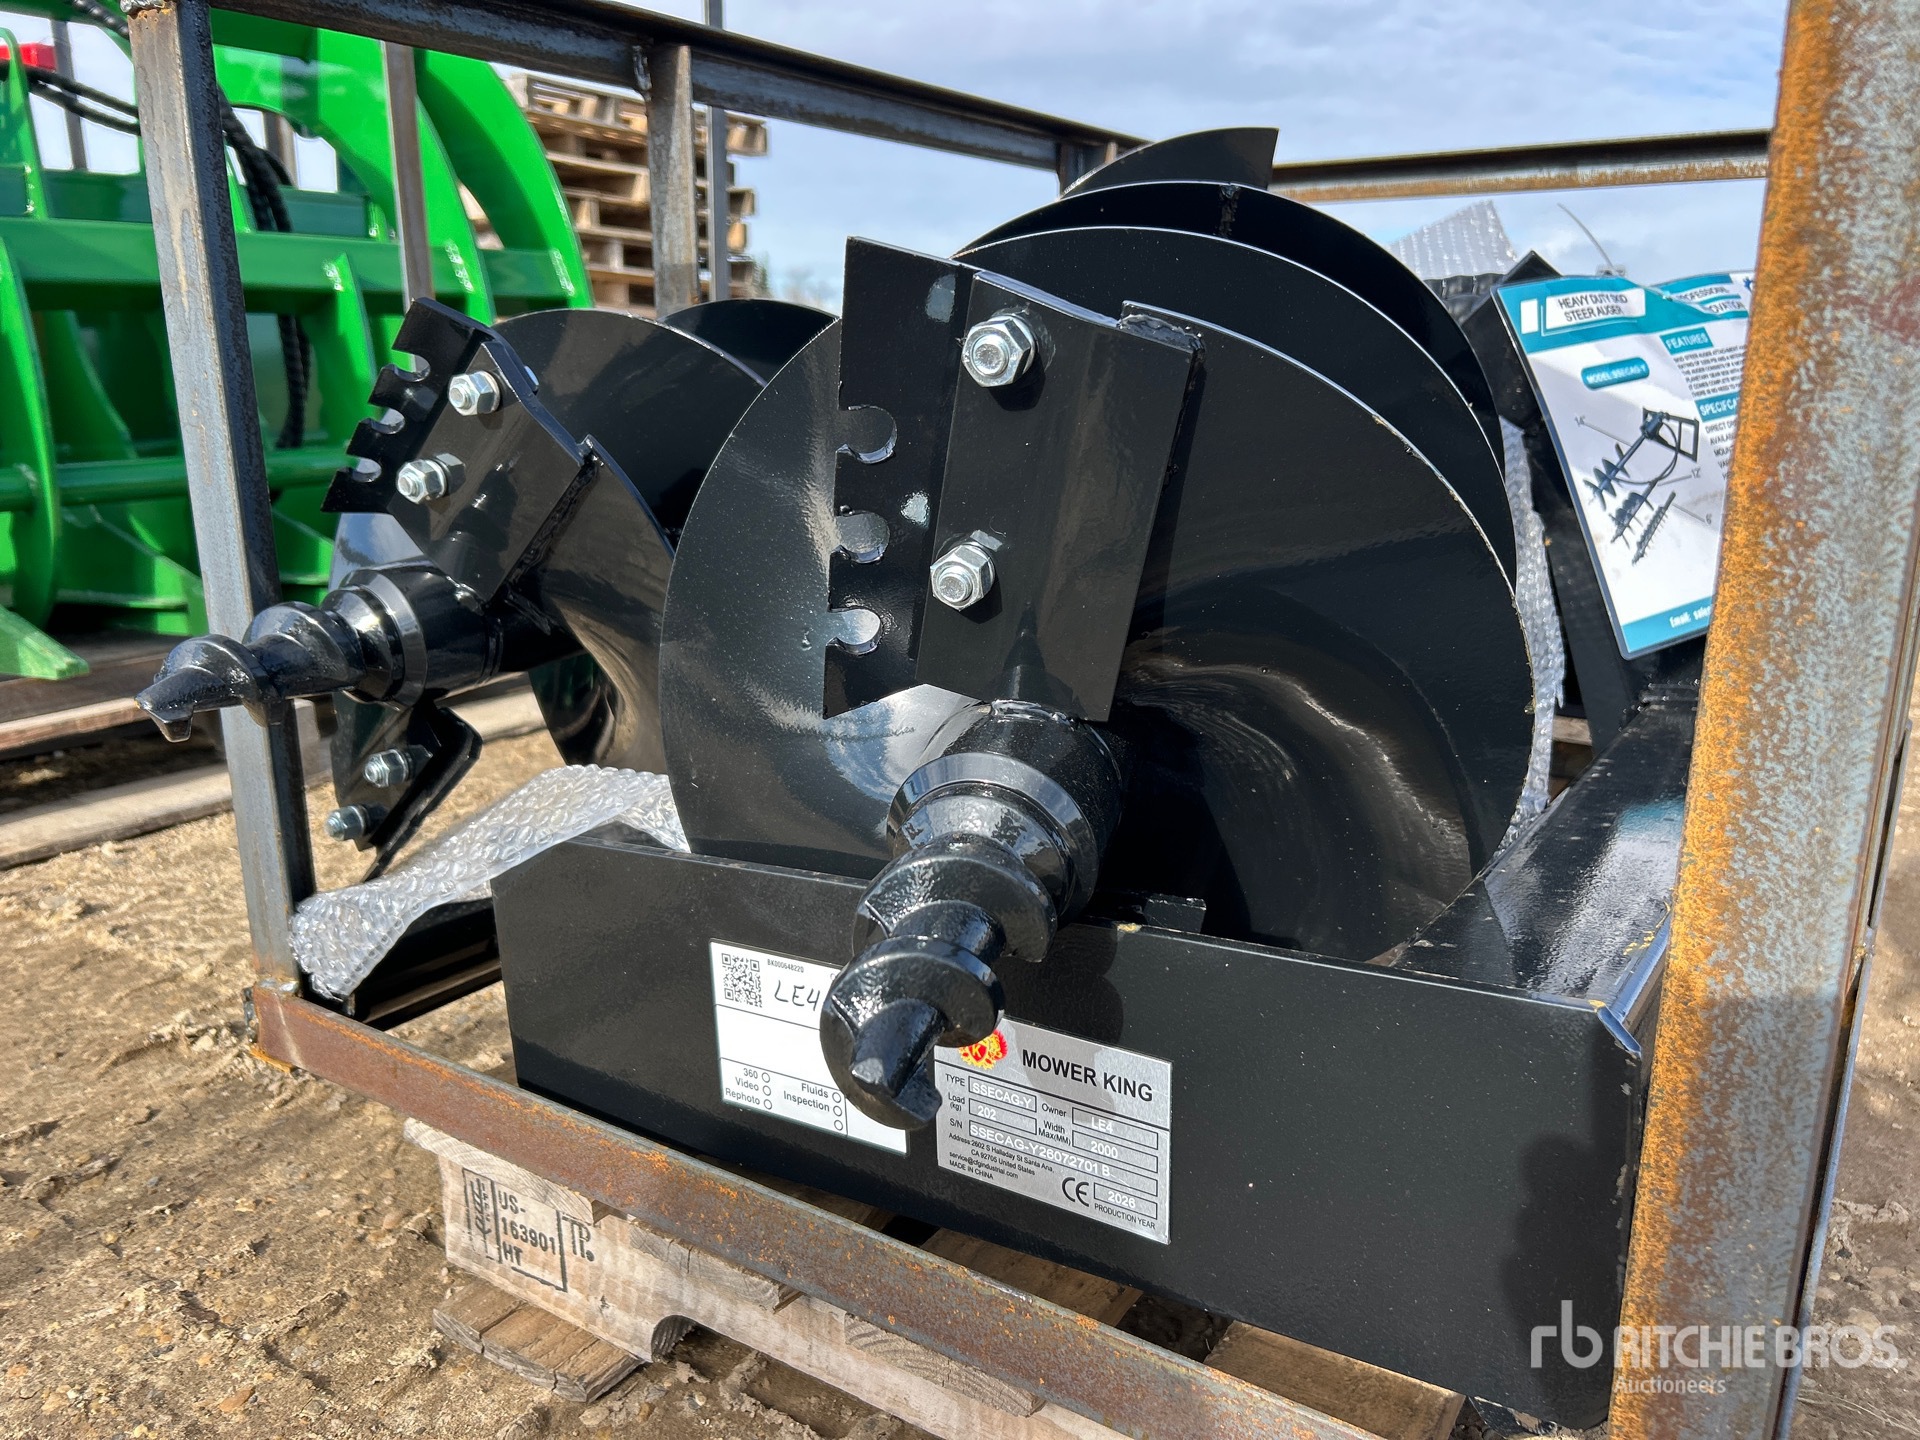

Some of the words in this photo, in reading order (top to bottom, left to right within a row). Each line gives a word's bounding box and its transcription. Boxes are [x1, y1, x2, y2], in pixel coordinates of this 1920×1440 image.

[1558, 294, 1589, 309] HEAVY
[1589, 294, 1610, 305] DUTY
[1564, 308, 1596, 322] STEER
[1597, 304, 1624, 316] AUGER
[1666, 332, 1708, 350] FEATURES
[1705, 421, 1726, 434] DIRECT
[774, 980, 820, 1011] LE4
[743, 1068, 758, 1079] 360
[1022, 1049, 1097, 1086] MOWER
[1104, 1072, 1153, 1102] KING
[735, 1077, 759, 1092] Video
[802, 1083, 828, 1098] Fluids
[946, 1074, 965, 1087] TYPE
[972, 1082, 1032, 1108] SSECAG-Y
[726, 1088, 760, 1106] Rephoto
[784, 1091, 830, 1112] Inspection
[948, 1092, 966, 1104] Load
[950, 1102, 962, 1112] (kg)
[978, 1106, 996, 1120] 202
[1042, 1103, 1066, 1118] Owner
[1091, 1116, 1113, 1133] LE4
[950, 1118, 962, 1129] S/N
[1044, 1120, 1066, 1134] Width
[1038, 1128, 1072, 1146] Max(MM)
[1090, 1141, 1118, 1159] 2000
[970, 1149, 980, 1157] CA
[981, 1152, 998, 1163] 92705
[998, 1158, 1016, 1170] United
[1018, 1164, 1036, 1176] States
[986, 1144, 991, 1152] S
[992, 1147, 1016, 1161] Halladay
[1016, 1154, 1023, 1162] St
[1024, 1157, 1040, 1168] Santa
[950, 1160, 966, 1171] MADE
[974, 1168, 994, 1180] CHINA
[498, 1190, 526, 1215] US-
[1108, 1190, 1136, 1208] 2026
[1094, 1202, 1136, 1224] PRODUCTION
[1138, 1217, 1156, 1230] YEAR
[501, 1216, 556, 1255] 163901
[502, 1241, 523, 1266] HT
